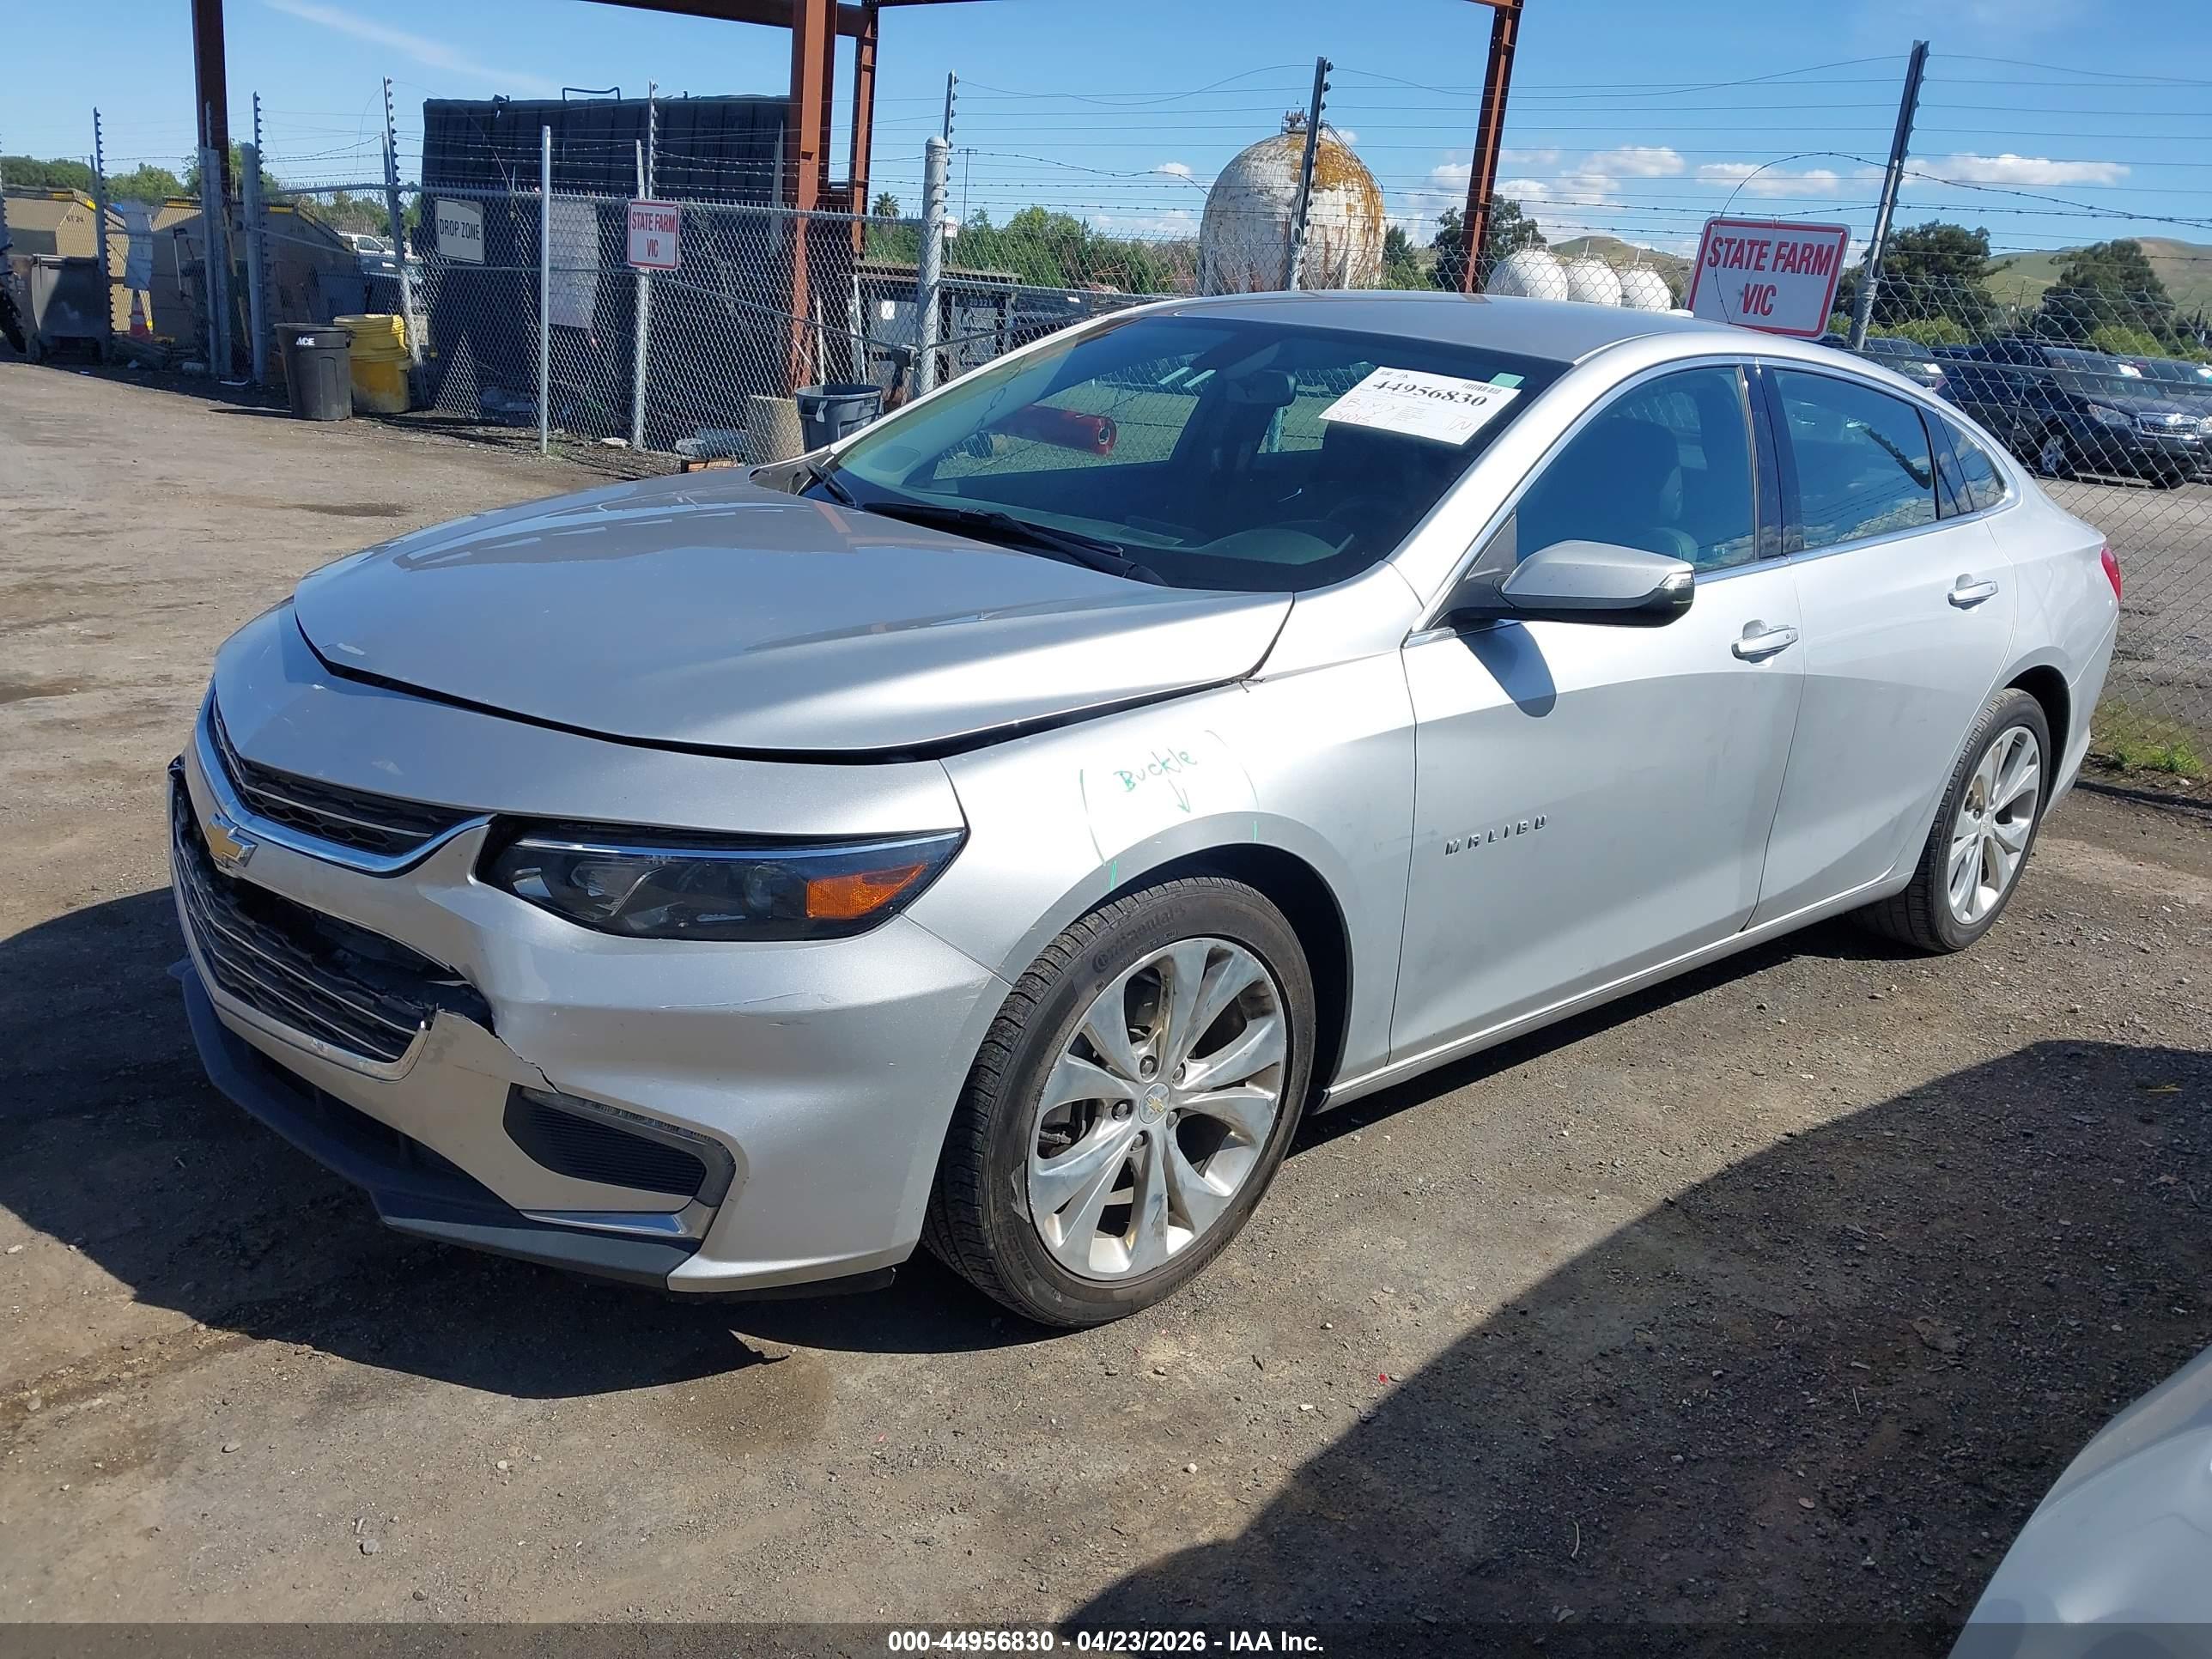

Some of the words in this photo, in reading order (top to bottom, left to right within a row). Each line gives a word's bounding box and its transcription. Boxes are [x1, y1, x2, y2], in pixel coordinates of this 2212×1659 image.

[439, 218, 459, 236] DROP
[461, 222, 480, 240] ZONE
[632, 211, 653, 231] STATE
[655, 213, 676, 233] FARM
[647, 238, 659, 258] VIC
[1707, 236, 1771, 271] STATE
[1771, 241, 1835, 276] FARM
[1742, 283, 1778, 316] VIC
[295, 336, 316, 345] ACE
[1372, 380, 1488, 406] 44956830
[1112, 748, 1199, 793] Buckle
[1444, 814, 1548, 856] MALIBU
